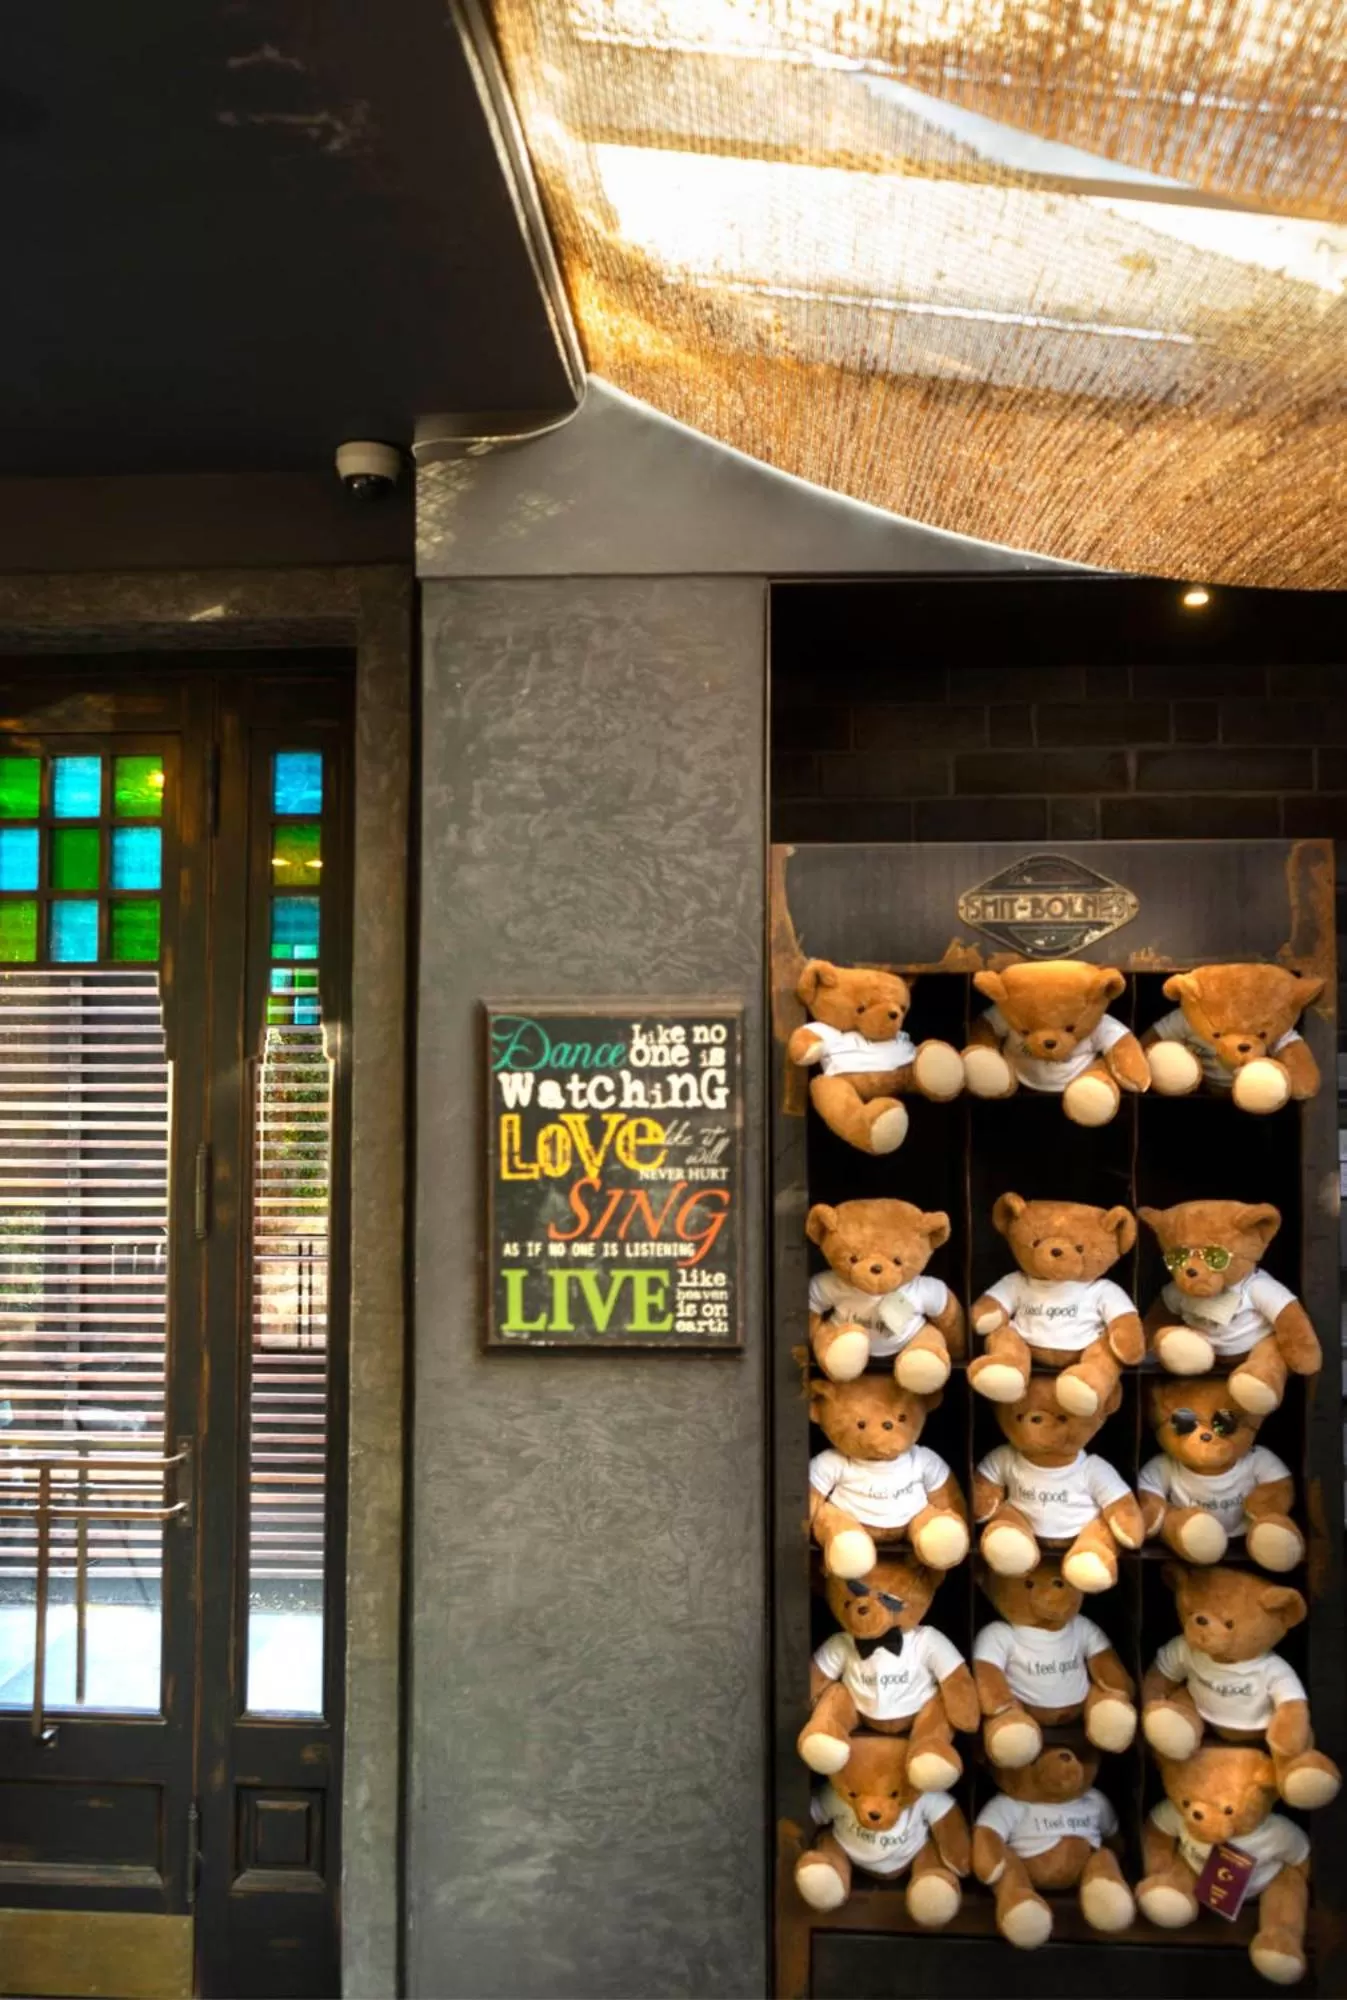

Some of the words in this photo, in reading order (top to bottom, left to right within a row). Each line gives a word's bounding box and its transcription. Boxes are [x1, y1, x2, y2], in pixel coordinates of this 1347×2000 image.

[489, 1015, 627, 1072] Dance
[692, 1023, 728, 1045] no
[638, 1167, 684, 1181] NEVER
[688, 1167, 730, 1181] HURT
[503, 1242, 520, 1257] AS
[526, 1242, 543, 1257] IF
[548, 1242, 566, 1257] NO
[571, 1242, 596, 1257] ONE
[602, 1242, 619, 1257] IS
[624, 1242, 697, 1258] LISTENING
[676, 1268, 727, 1288] like
[501, 1268, 675, 1333] LIVE
[675, 1302, 698, 1318] is
[701, 1302, 729, 1318] on
[675, 1318, 729, 1333] earth
[879, 1669, 910, 1691] good
